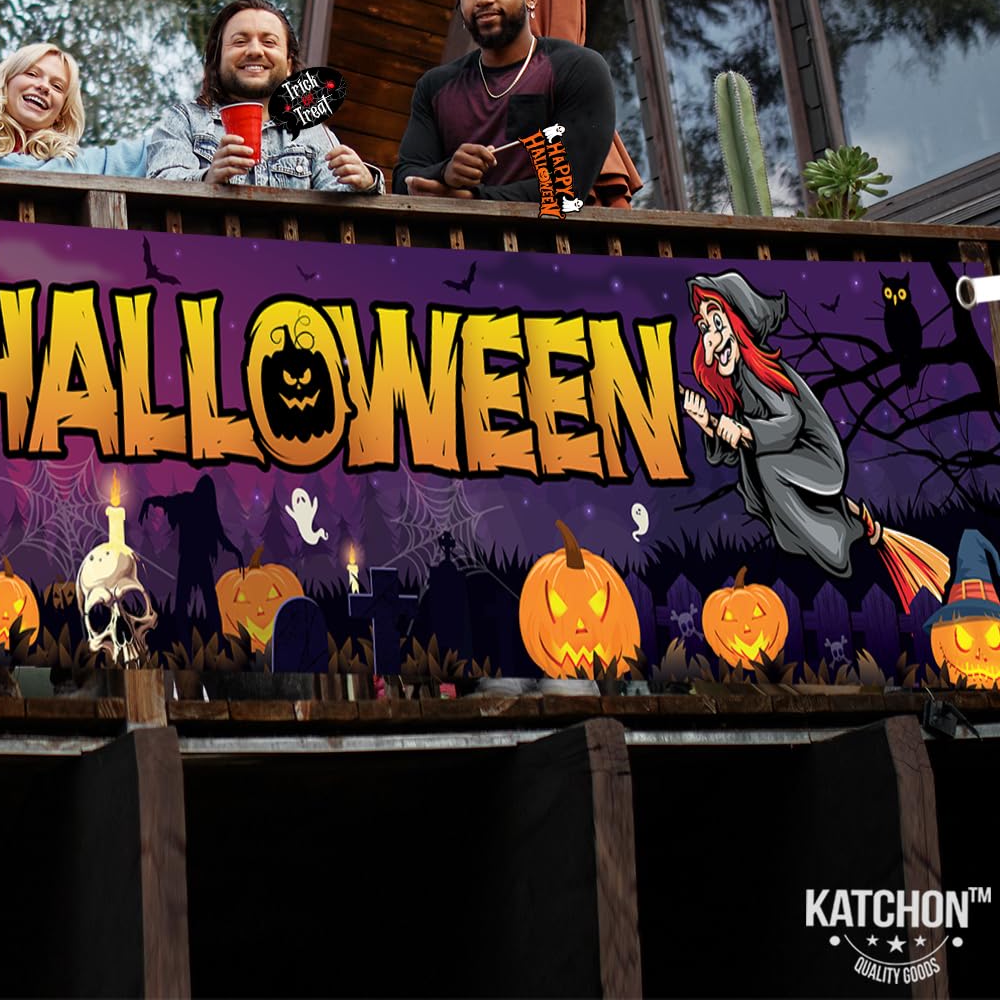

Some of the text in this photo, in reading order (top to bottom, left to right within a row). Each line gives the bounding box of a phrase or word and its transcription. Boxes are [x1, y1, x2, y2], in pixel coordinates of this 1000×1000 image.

[282, 70, 320, 101] Trick
[293, 94, 332, 126] Treat
[519, 128, 565, 219] HALLOWEEN
[546, 141, 575, 199] HAPPY
